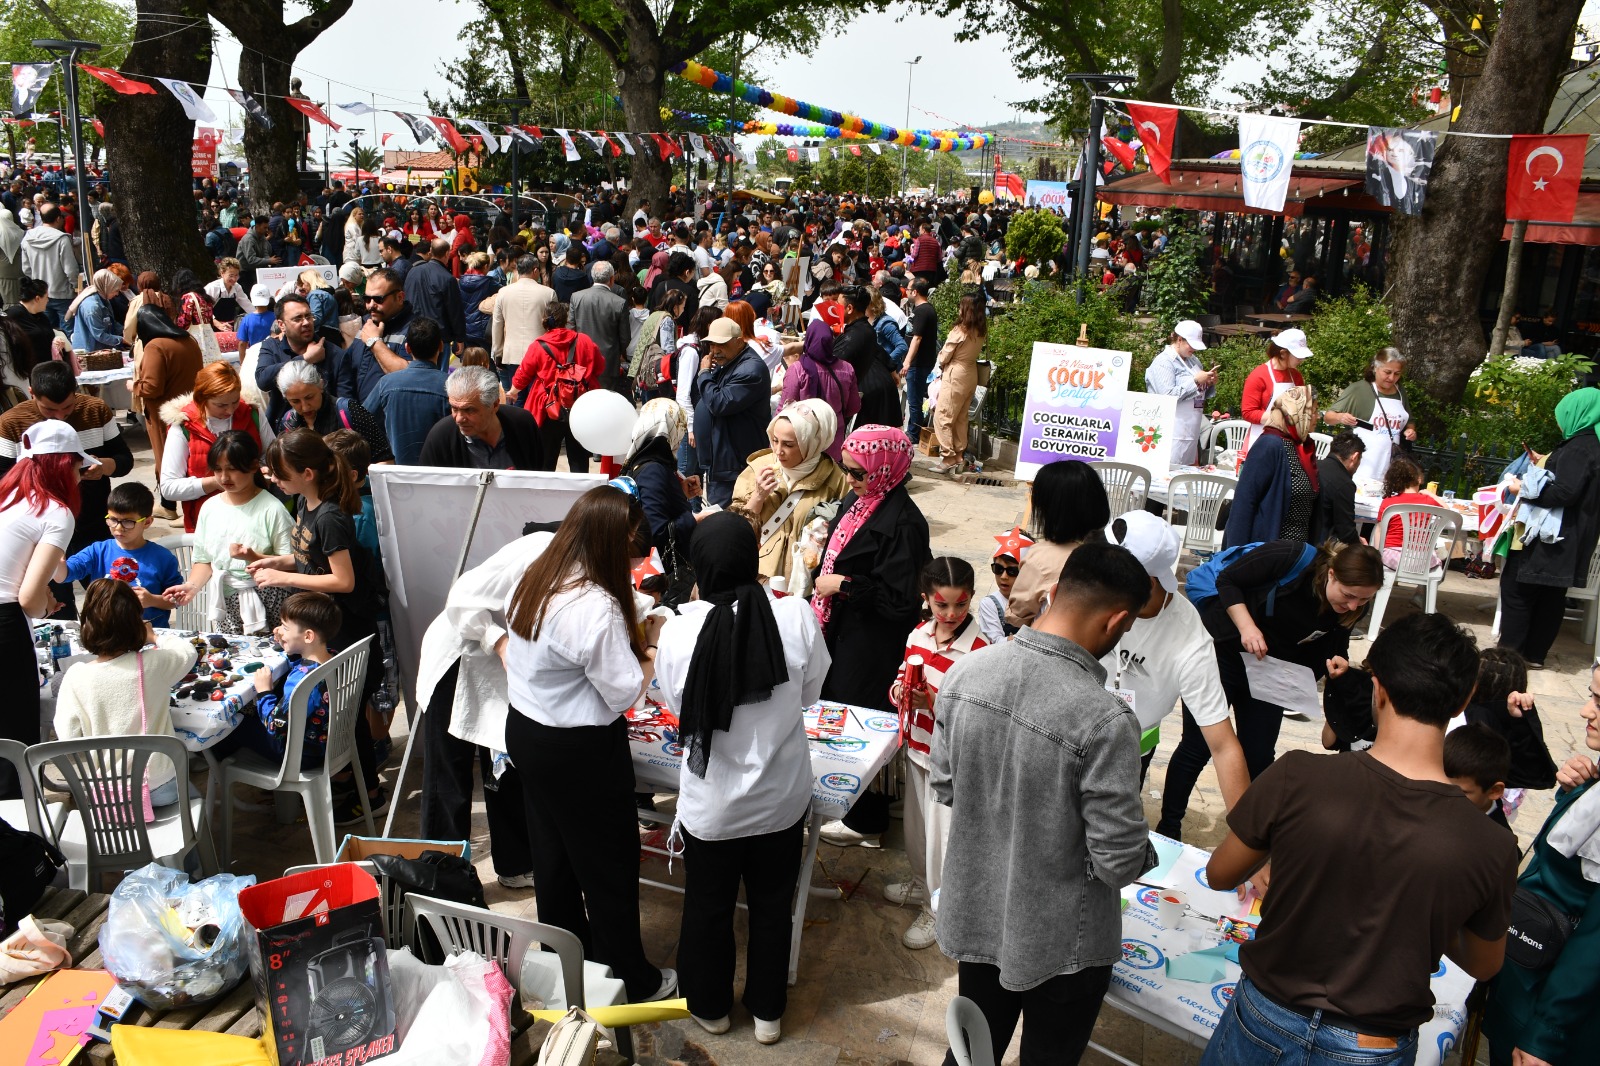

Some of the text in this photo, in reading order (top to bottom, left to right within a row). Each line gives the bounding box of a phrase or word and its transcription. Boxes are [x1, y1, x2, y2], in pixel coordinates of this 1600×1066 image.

[1040, 193, 1066, 207] ÇOCUK
[1048, 366, 1105, 392] ÇOCUK
[1033, 412, 1111, 431] ÇOCUKLARLA
[1044, 427, 1097, 443] SERAMİK
[1032, 439, 1106, 457] BOYUYORUZ
[1519, 931, 1543, 950] Jeans
[1111, 975, 1143, 994] DİYESİ
[1128, 973, 1163, 991] EREĞLİ
[1177, 995, 1221, 1019] KARADEN
